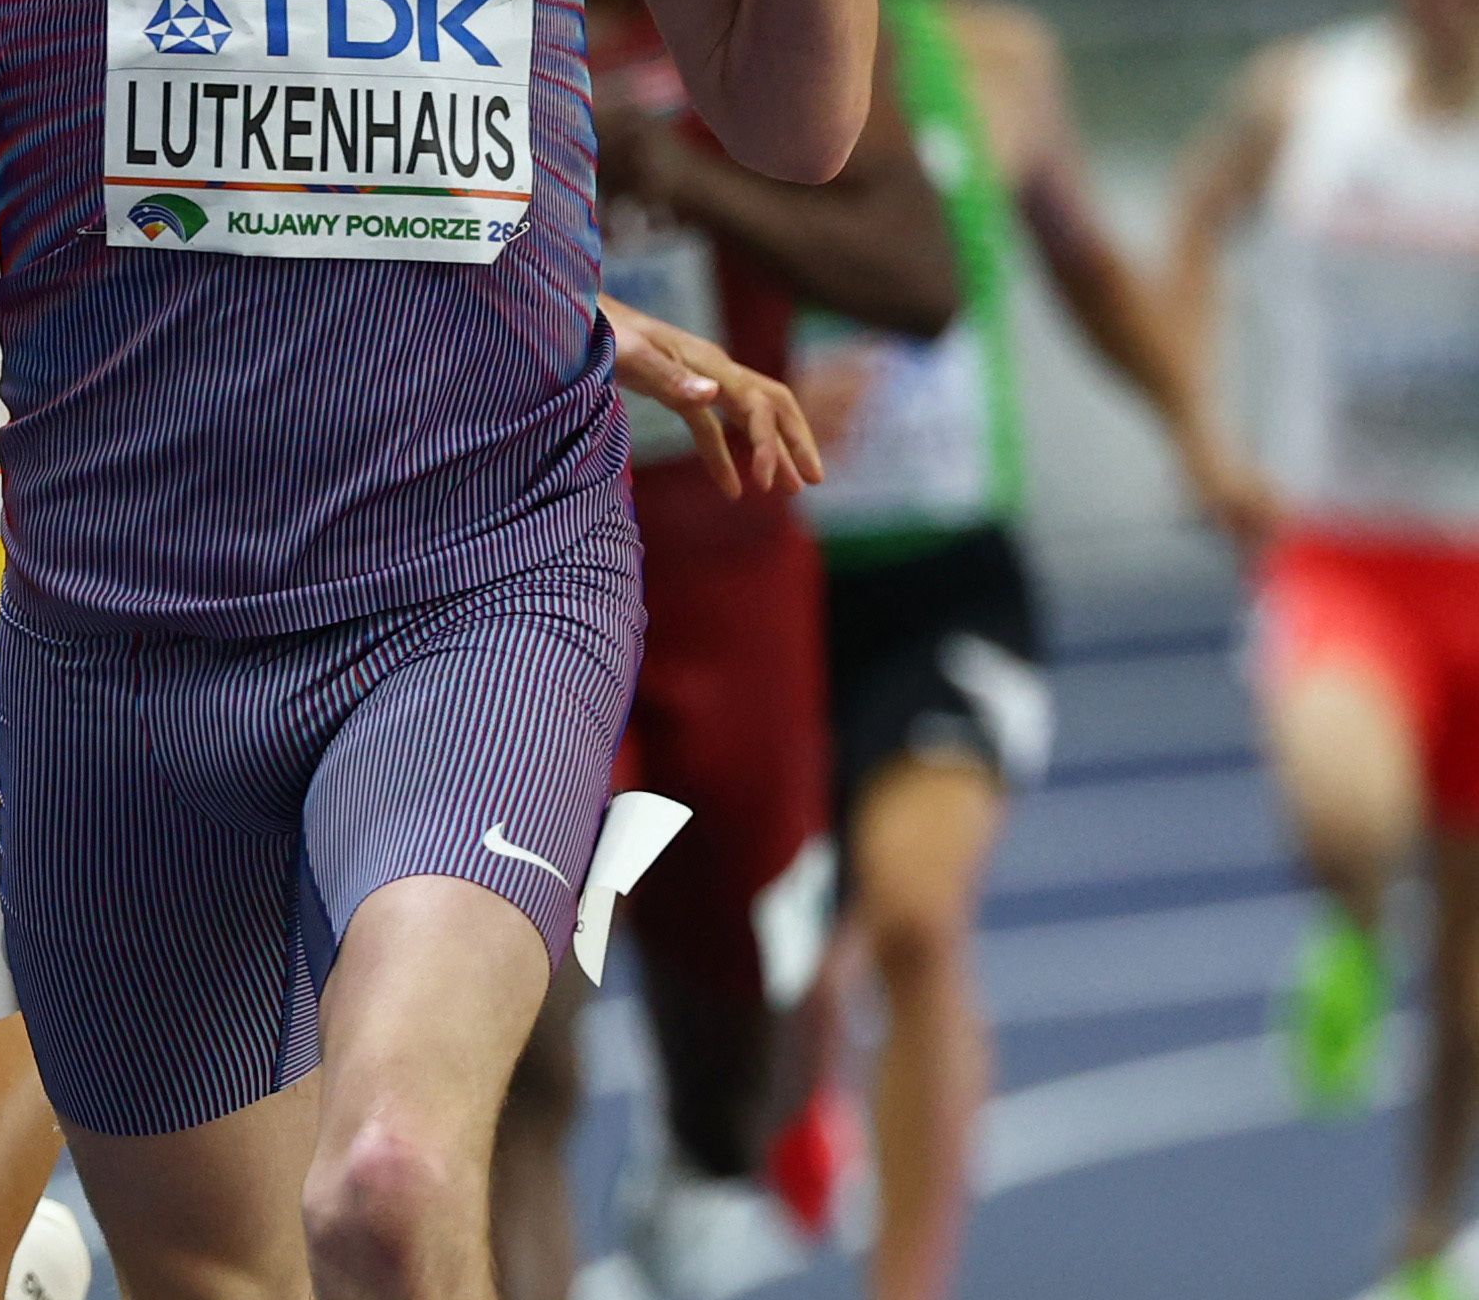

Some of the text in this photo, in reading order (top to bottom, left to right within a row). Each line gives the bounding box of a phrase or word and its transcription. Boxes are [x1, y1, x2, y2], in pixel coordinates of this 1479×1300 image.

[125, 80, 516, 181] LUTKENHAUS
[227, 211, 342, 237] KUJAWY
[345, 215, 481, 241] POMORZE
